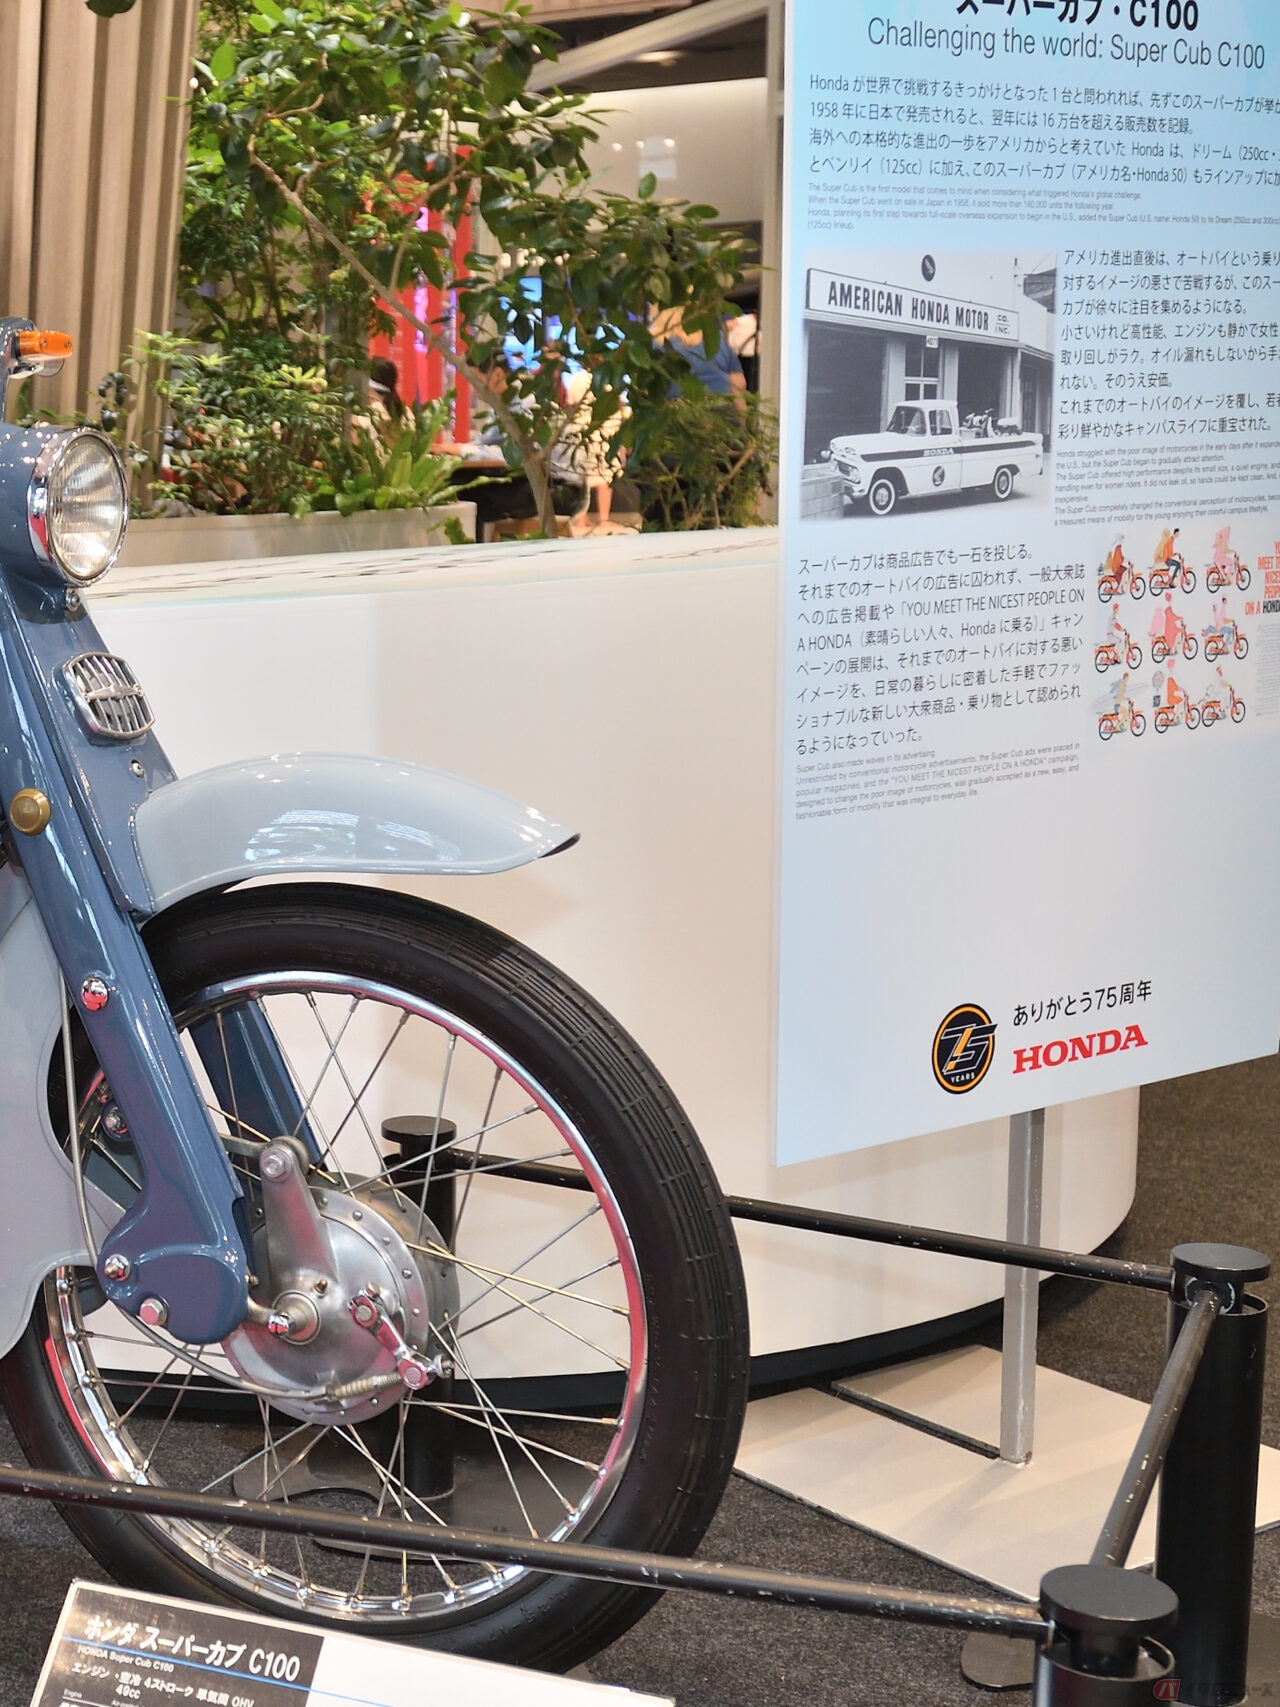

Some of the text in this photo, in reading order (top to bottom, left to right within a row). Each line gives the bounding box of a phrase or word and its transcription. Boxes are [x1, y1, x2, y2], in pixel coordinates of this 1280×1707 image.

[868, 16, 1265, 69] Challenging the world: Super Cub C100
[810, 74, 849, 90] Honda
[811, 102, 839, 118] 1958
[1043, 113, 1055, 127] 16
[1058, 113, 1193, 134] 万台を超える販売数を記録。
[1132, 141, 1164, 157] Honda
[828, 281, 989, 331] AMERICAN HONDA MOTOR
[1062, 299, 1248, 316] カブが徐々に注目を集めるようになる。
[1061, 346, 1280, 366] 取り回しがラク。オイル漏れもしないから手
[1060, 372, 1173, 390] れない。そのうえ安価。
[798, 544, 1032, 574] スーパーカブは商品広告でも一石を投じる。
[933, 598, 963, 615] MEET
[965, 596, 986, 612] THE
[988, 593, 1025, 609] NICEST
[1028, 589, 1066, 607] PEOPLE
[1068, 588, 1085, 602] ON
[1263, 600, 1280, 614] HOND
[797, 638, 805, 652] A
[961, 620, 996, 637] Honda
[796, 727, 923, 755] るようになっていった。
[1012, 979, 1153, 1027] ありがとう75周年
[1012, 1024, 1149, 1074] HONDA
[950, 1072, 976, 1083] YEARS
[77, 1645, 175, 1673] HONDA Super Cub C100
[84, 1615, 301, 1682] ホンダ スーパーカブ C100
[71, 1662, 110, 1679] エンジン
[144, 1677, 194, 1697] 4ストローク
[231, 1695, 255, 1707] OHV
[115, 1683, 141, 1700] 49cc
